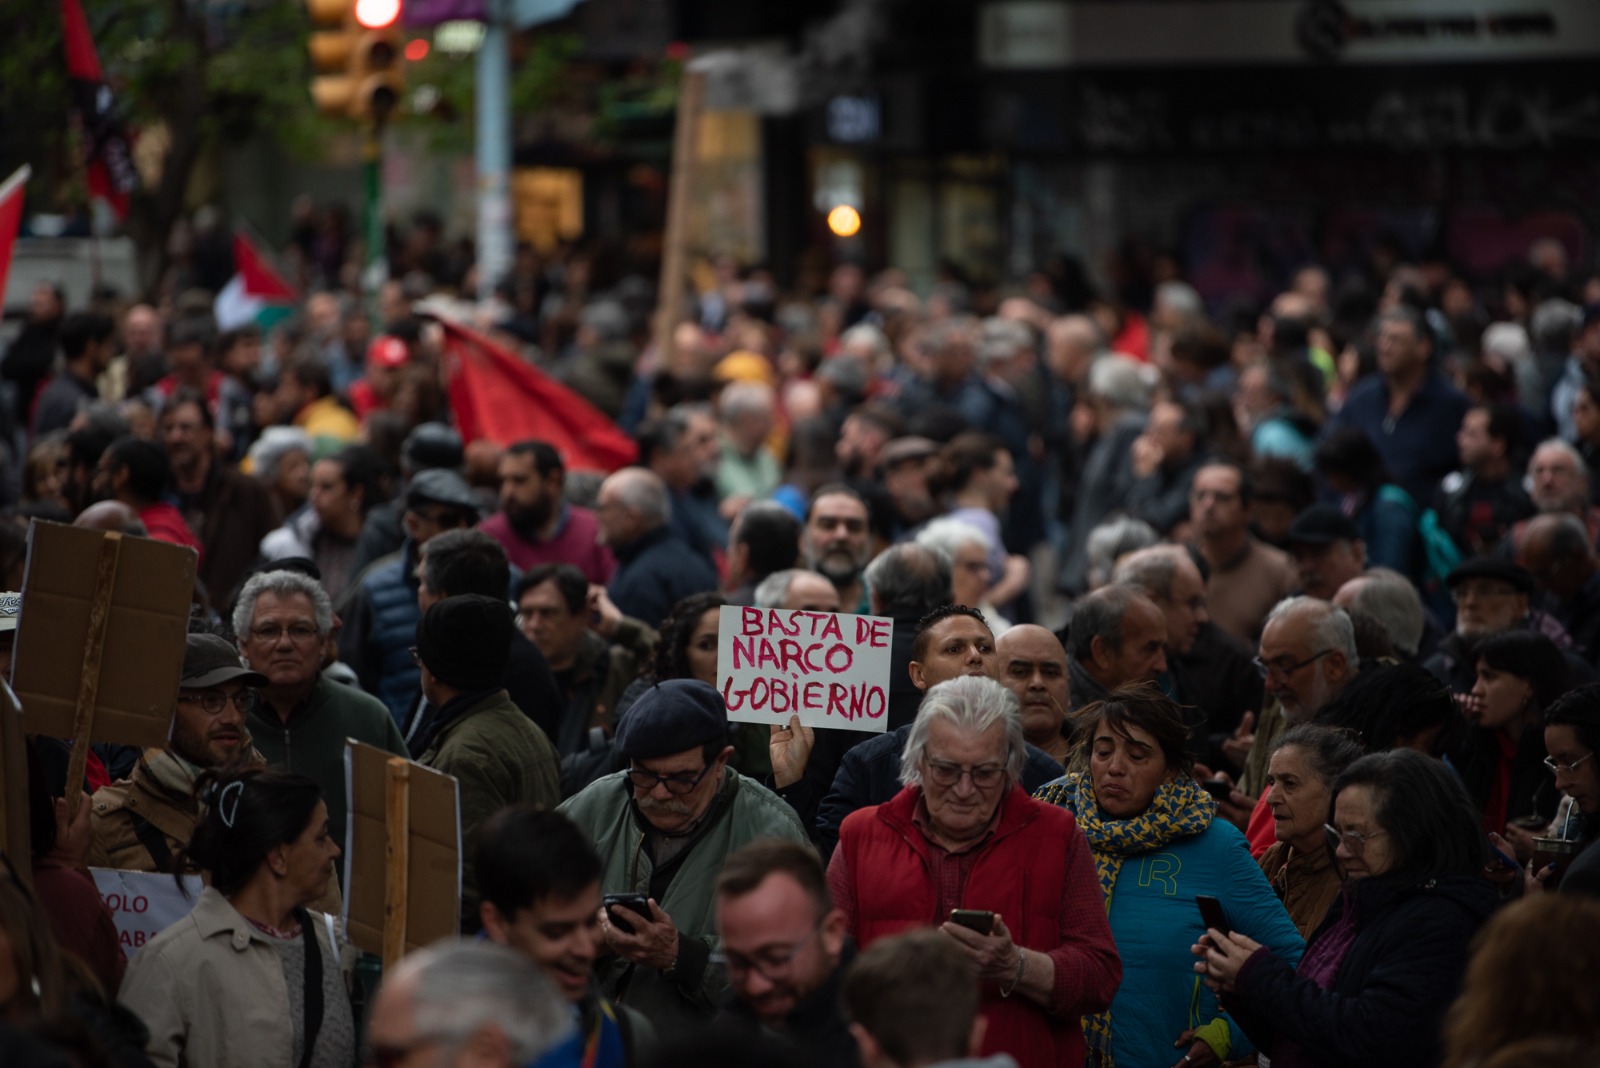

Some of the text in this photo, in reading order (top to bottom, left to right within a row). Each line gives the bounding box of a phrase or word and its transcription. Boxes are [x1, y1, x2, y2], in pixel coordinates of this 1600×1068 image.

[740, 606, 891, 648] BASTA DE
[732, 635, 854, 675] NARCO
